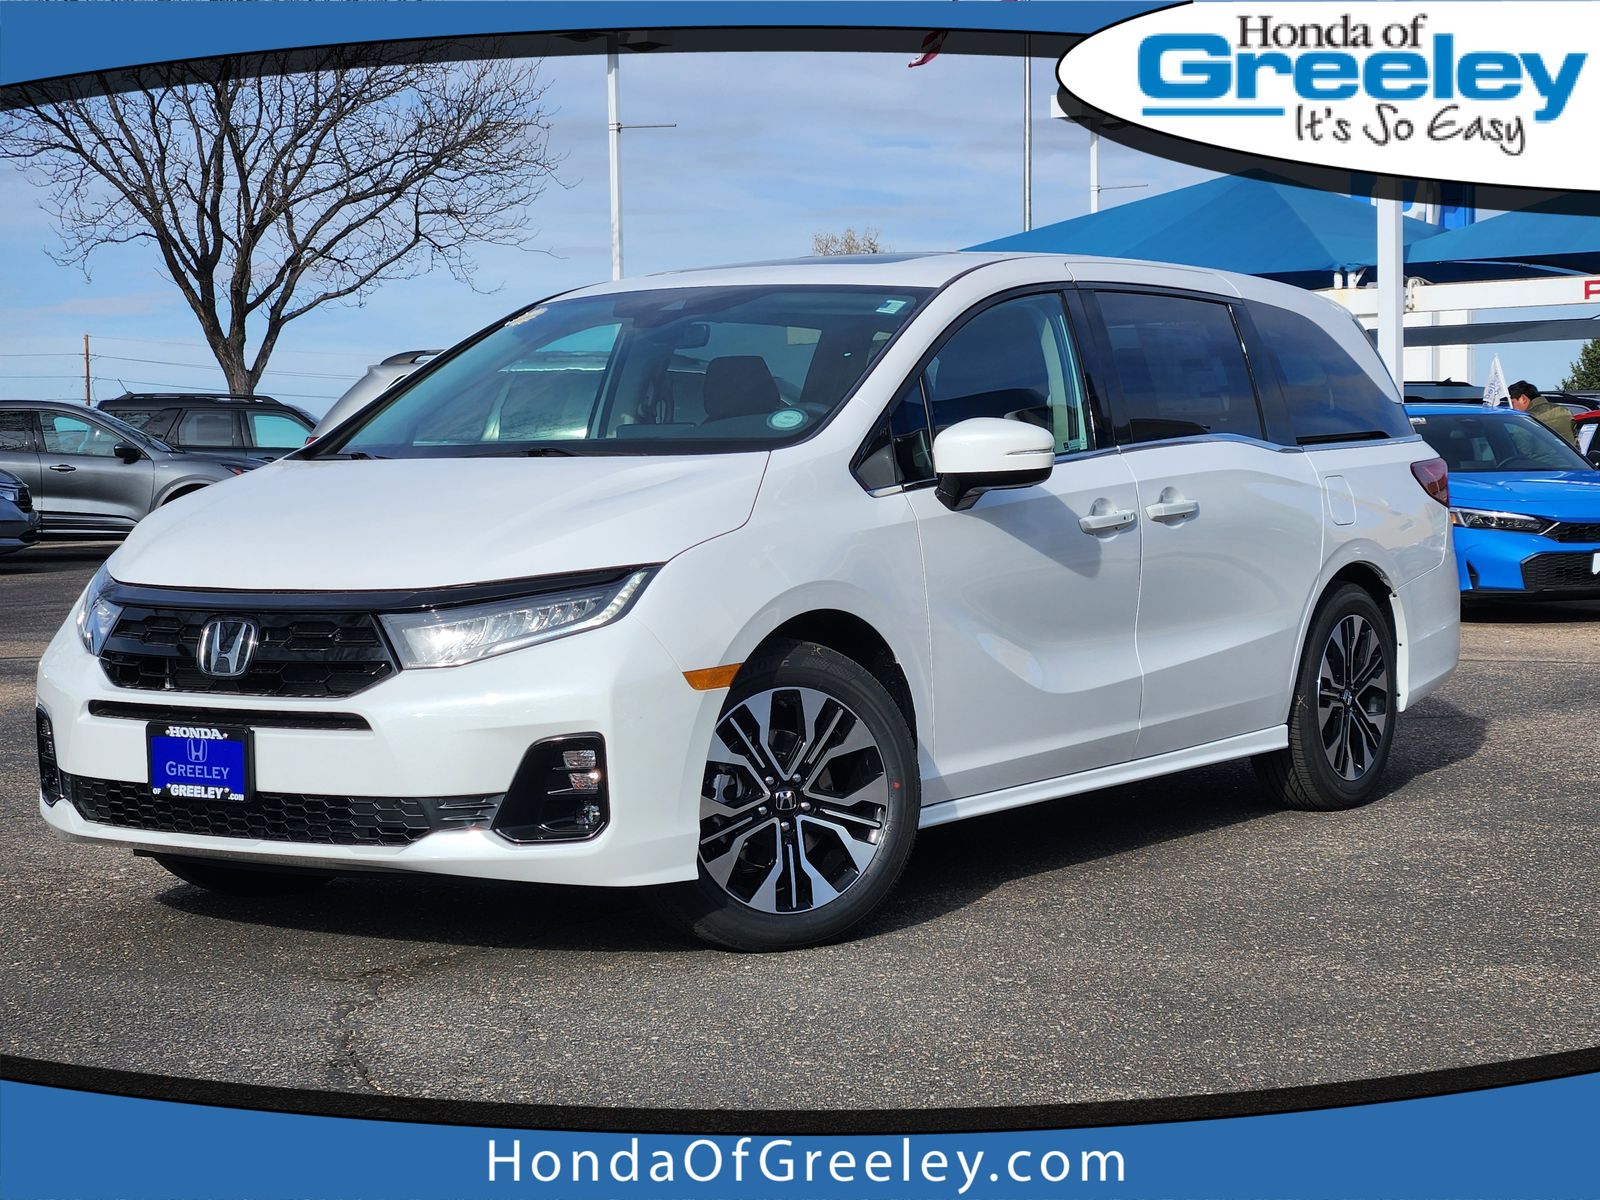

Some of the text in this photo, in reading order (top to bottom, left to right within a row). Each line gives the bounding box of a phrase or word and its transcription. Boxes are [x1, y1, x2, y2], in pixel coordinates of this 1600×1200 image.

[167, 725, 224, 741] HONDA
[165, 760, 230, 780] GREELEY
[152, 787, 162, 795] OF
[170, 784, 224, 800] GREELEY
